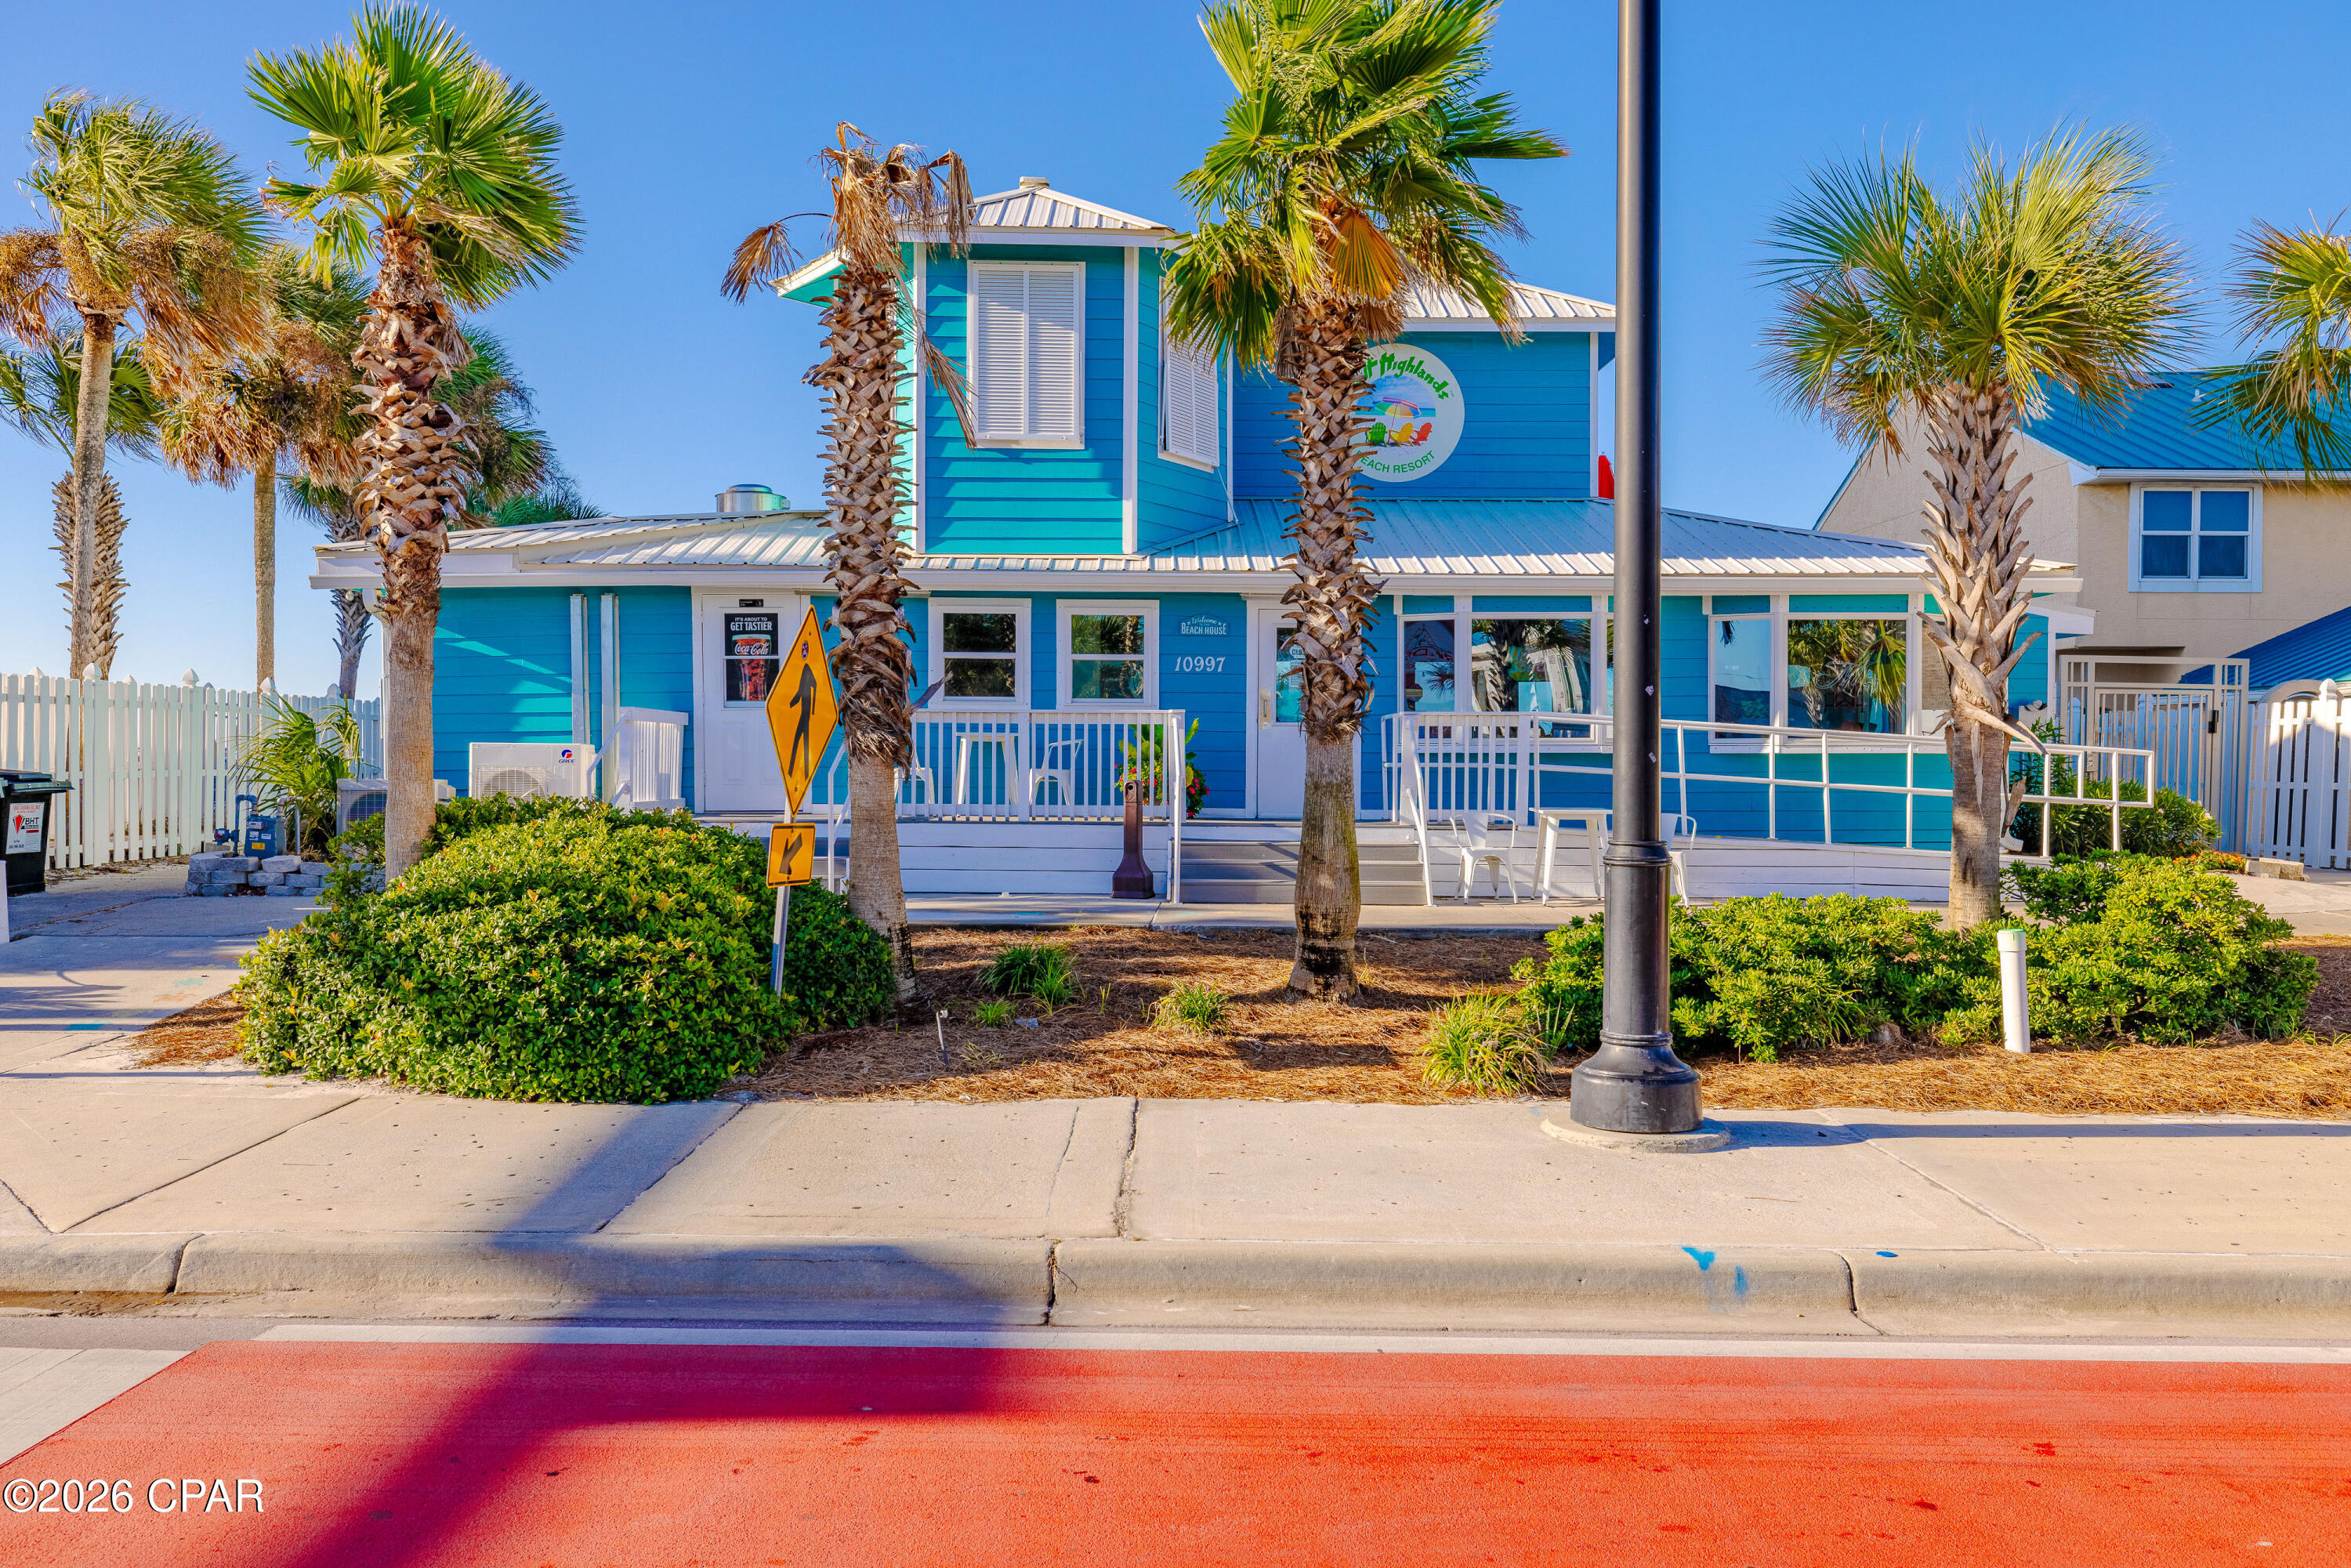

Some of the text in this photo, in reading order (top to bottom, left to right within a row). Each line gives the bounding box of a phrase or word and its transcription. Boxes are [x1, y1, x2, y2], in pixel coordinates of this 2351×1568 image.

[1379, 352, 1449, 400] Highlands
[1356, 450, 1435, 473] EACH RESORT
[730, 621, 773, 631] GET TASTIER
[1191, 614, 1218, 625] Welcome
[1181, 622, 1227, 635] BEACH HOUSE
[734, 642, 770, 655] Coca-Cola
[1175, 656, 1226, 672] 10997
